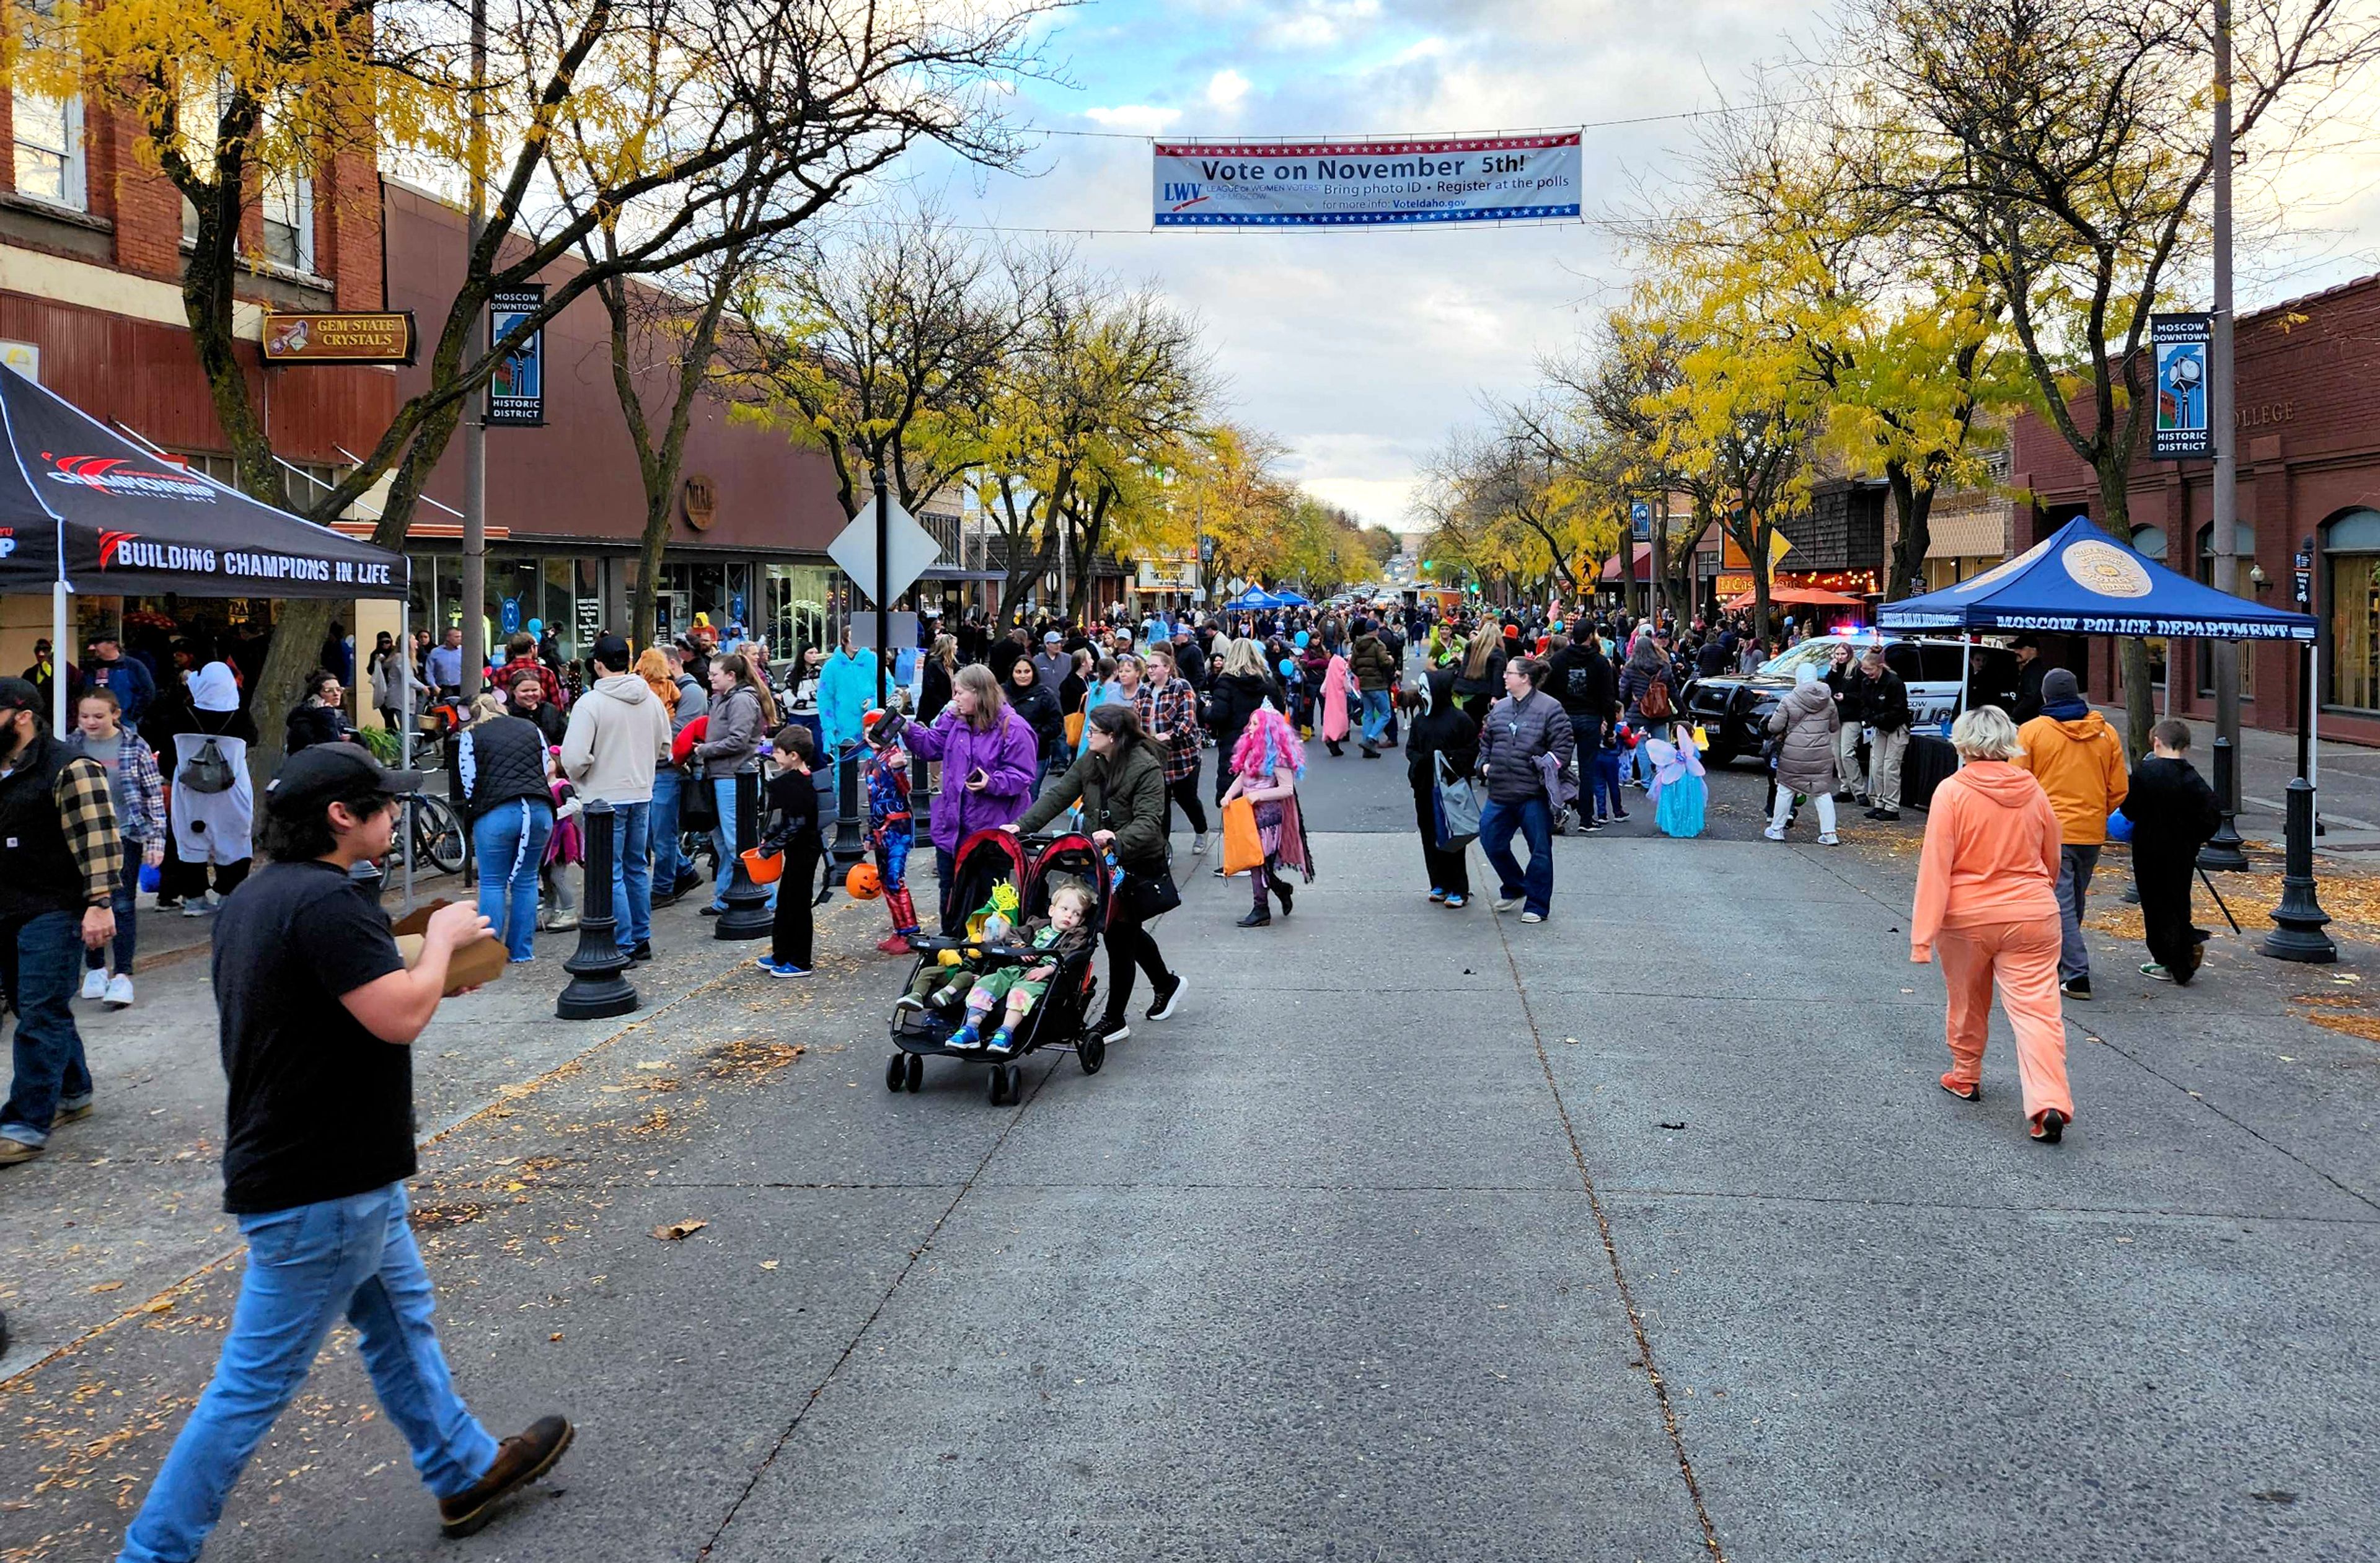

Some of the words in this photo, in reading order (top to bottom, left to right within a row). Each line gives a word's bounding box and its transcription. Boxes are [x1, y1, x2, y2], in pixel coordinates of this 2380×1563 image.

[1202, 160, 1265, 180] Vote
[1274, 166, 1308, 180] on
[1318, 157, 1465, 179] November
[1482, 155, 1525, 174] 5th!
[1206, 185, 1240, 193] LEAGUE
[1324, 185, 1359, 196] Bring
[1364, 183, 1403, 196] photo
[1408, 182, 1421, 193] ID
[1437, 180, 1491, 195] Register
[1496, 180, 1509, 190] at
[1512, 177, 1533, 188] the
[1537, 175, 1569, 190] polls
[1164, 183, 1201, 201] LWV
[1323, 200, 1336, 208] for
[1367, 199, 1391, 208] info:
[1393, 198, 1466, 208] VoteIdaho.gov
[495, 293, 539, 301] MOSCOW
[317, 320, 348, 332] GEM
[352, 320, 394, 332] STATE
[2157, 323, 2205, 332] MOSCOW
[323, 334, 392, 346] CRYSTALS
[2153, 333, 2210, 341] DOWNTOWN
[493, 400, 540, 408] HISTORIC
[494, 410, 539, 418] DISTRICT
[2233, 402, 2294, 429] OLLEGE
[2157, 431, 2207, 441] HISTORIC
[2157, 442, 2206, 451] DISTRICT
[47, 472, 216, 497] CHAMPIONSHIP
[118, 540, 216, 573] BUILDING
[224, 551, 329, 583] CHAMPIONS
[336, 561, 352, 584] IN
[357, 563, 390, 585] LIFE
[1732, 577, 1755, 590] Cas
[1996, 615, 2078, 631] MOSCOW
[2083, 618, 2151, 633] POLICE
[2157, 620, 2289, 638] DEPARTMENT
